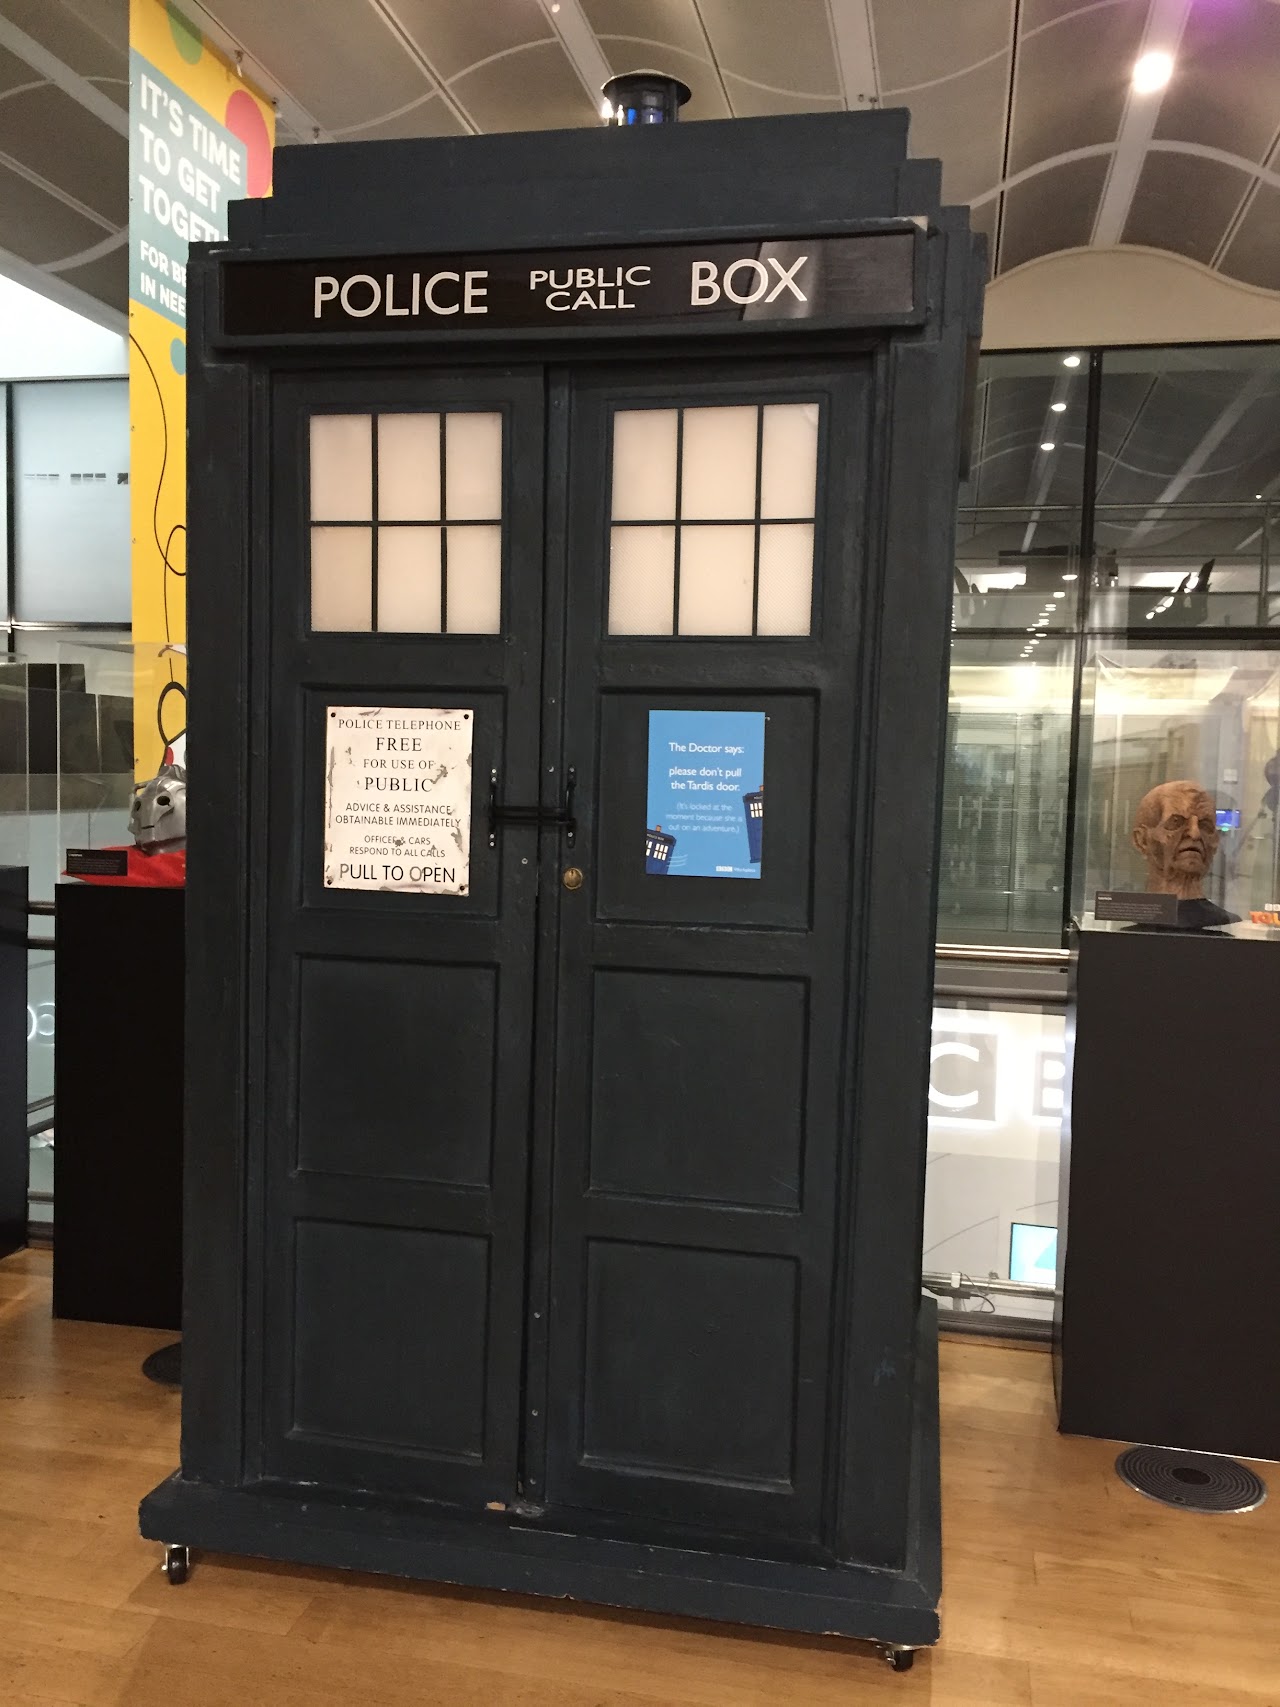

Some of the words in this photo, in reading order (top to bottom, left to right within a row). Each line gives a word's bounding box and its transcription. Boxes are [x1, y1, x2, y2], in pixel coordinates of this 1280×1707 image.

[140, 74, 185, 138] IT'S
[189, 112, 242, 185] TIME
[139, 123, 172, 176] TO
[178, 156, 221, 213] GET
[140, 240, 169, 275] FOR
[140, 272, 156, 299] IN
[314, 270, 489, 319] POLICE
[529, 265, 652, 290] PUBLIC
[690, 256, 809, 306] BOX
[545, 290, 636, 312] CALL
[338, 718, 383, 729] POLICE
[388, 719, 461, 731] TELEPHONE
[376, 737, 423, 752] FREE
[669, 742, 686, 752] The
[688, 742, 722, 753] Doctor
[724, 746, 745, 756] says:
[363, 758, 387, 769] FOR
[391, 759, 414, 770] USE
[418, 759, 435, 770] OF
[669, 766, 697, 778] please
[699, 767, 723, 777] don't
[725, 768, 742, 779] pull
[364, 777, 433, 792] PUBLIC
[671, 781, 686, 790] the
[687, 781, 714, 791] Tardis
[346, 802, 381, 813] ADVICE
[383, 803, 391, 813] &
[393, 803, 452, 815] ASSISTANCE
[721, 803, 732, 811] the
[335, 815, 394, 826] OBTAINABLE
[396, 816, 462, 828] IMMEDIATELY
[696, 814, 723, 822] because
[408, 836, 431, 845] CARS
[349, 847, 388, 857] RESPOND
[391, 848, 402, 856] TO
[404, 848, 418, 857] ALL
[420, 849, 446, 858] CALLS
[339, 863, 378, 881] PULL
[382, 865, 404, 882] TO
[409, 866, 456, 883] OPEN
